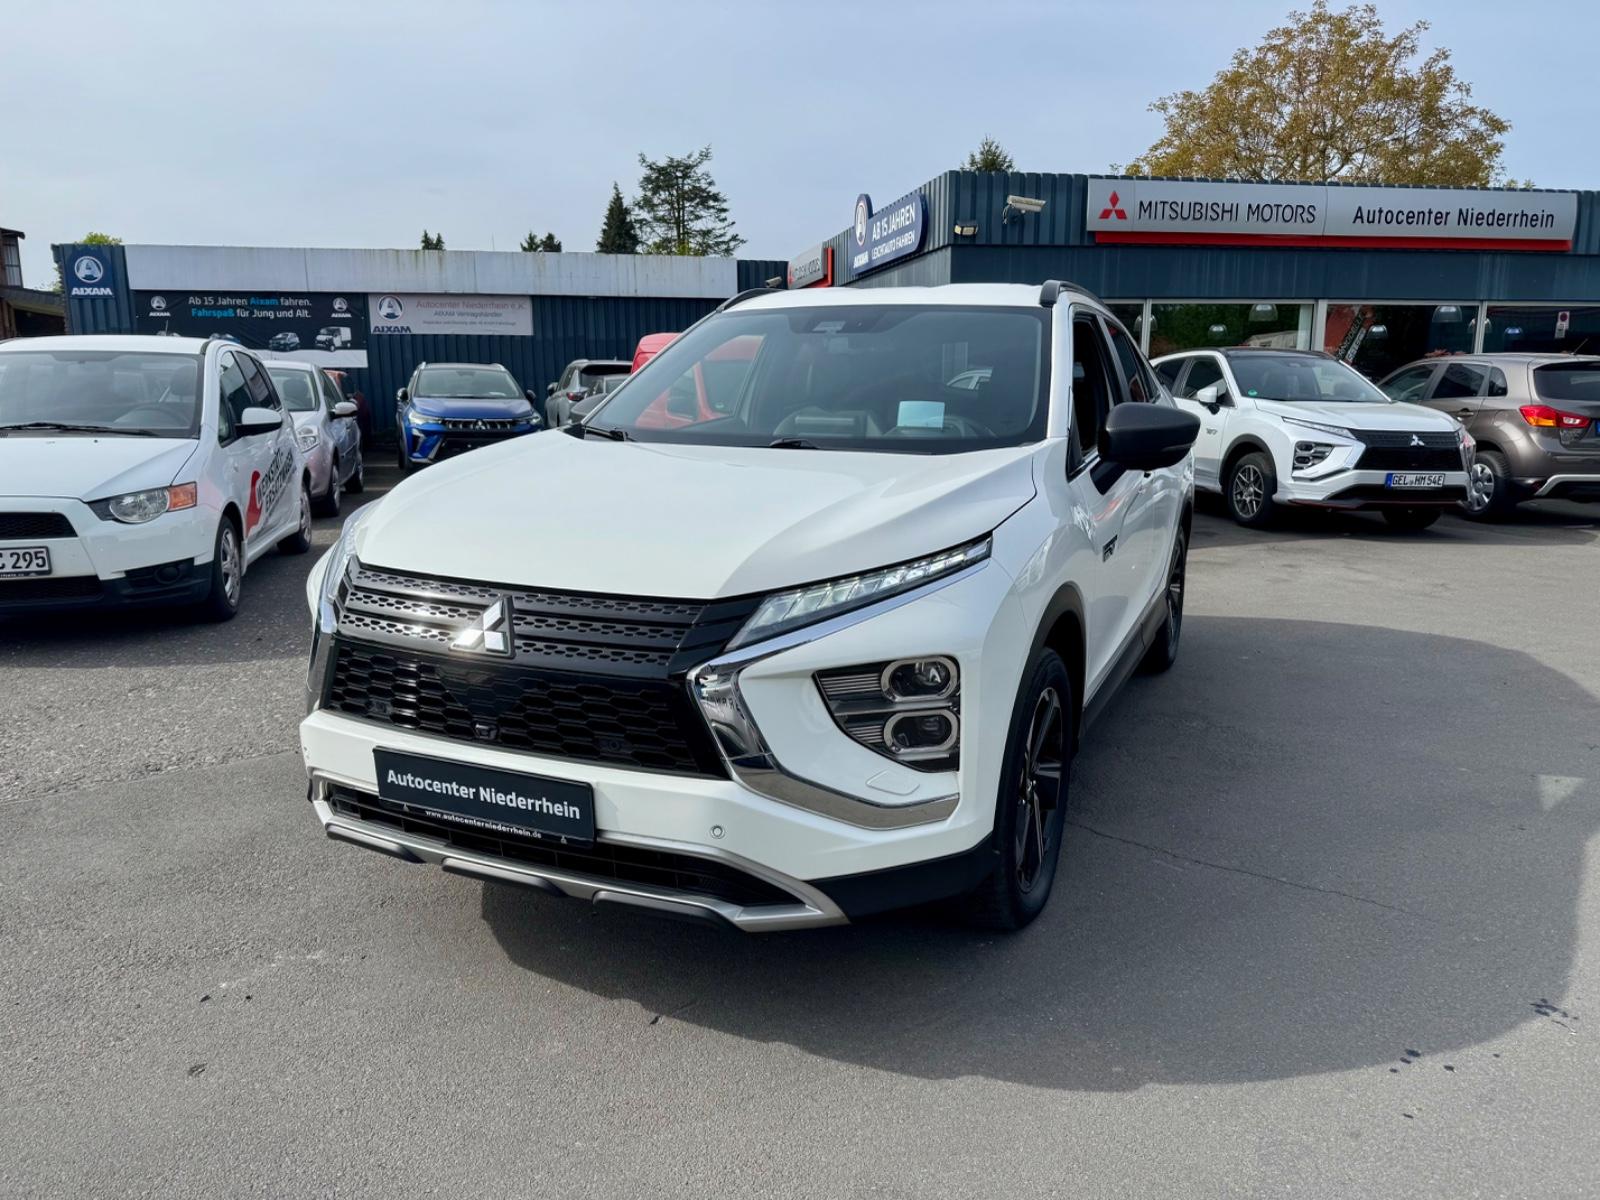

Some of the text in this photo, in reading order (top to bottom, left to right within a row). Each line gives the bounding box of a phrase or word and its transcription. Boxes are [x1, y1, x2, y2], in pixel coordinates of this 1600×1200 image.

[872, 202, 916, 241] AB 15 JAHREN
[1138, 200, 1316, 224] MITSUBISHI MOTORS
[1352, 206, 1555, 228] Autocenter Niederrhein
[71, 287, 113, 296] AIXAM
[188, 296, 312, 306] Ab 15 Jahren Aixam fahren.
[191, 308, 312, 320] Fahrspaß für Jung und Alt.
[373, 325, 412, 334] AIXAM
[1392, 475, 1408, 486] GEL
[10, 551, 46, 570] 295
[387, 769, 581, 820] Autocenter Niederrhein
[425, 809, 542, 839] www.autocenterniederrhein.de
